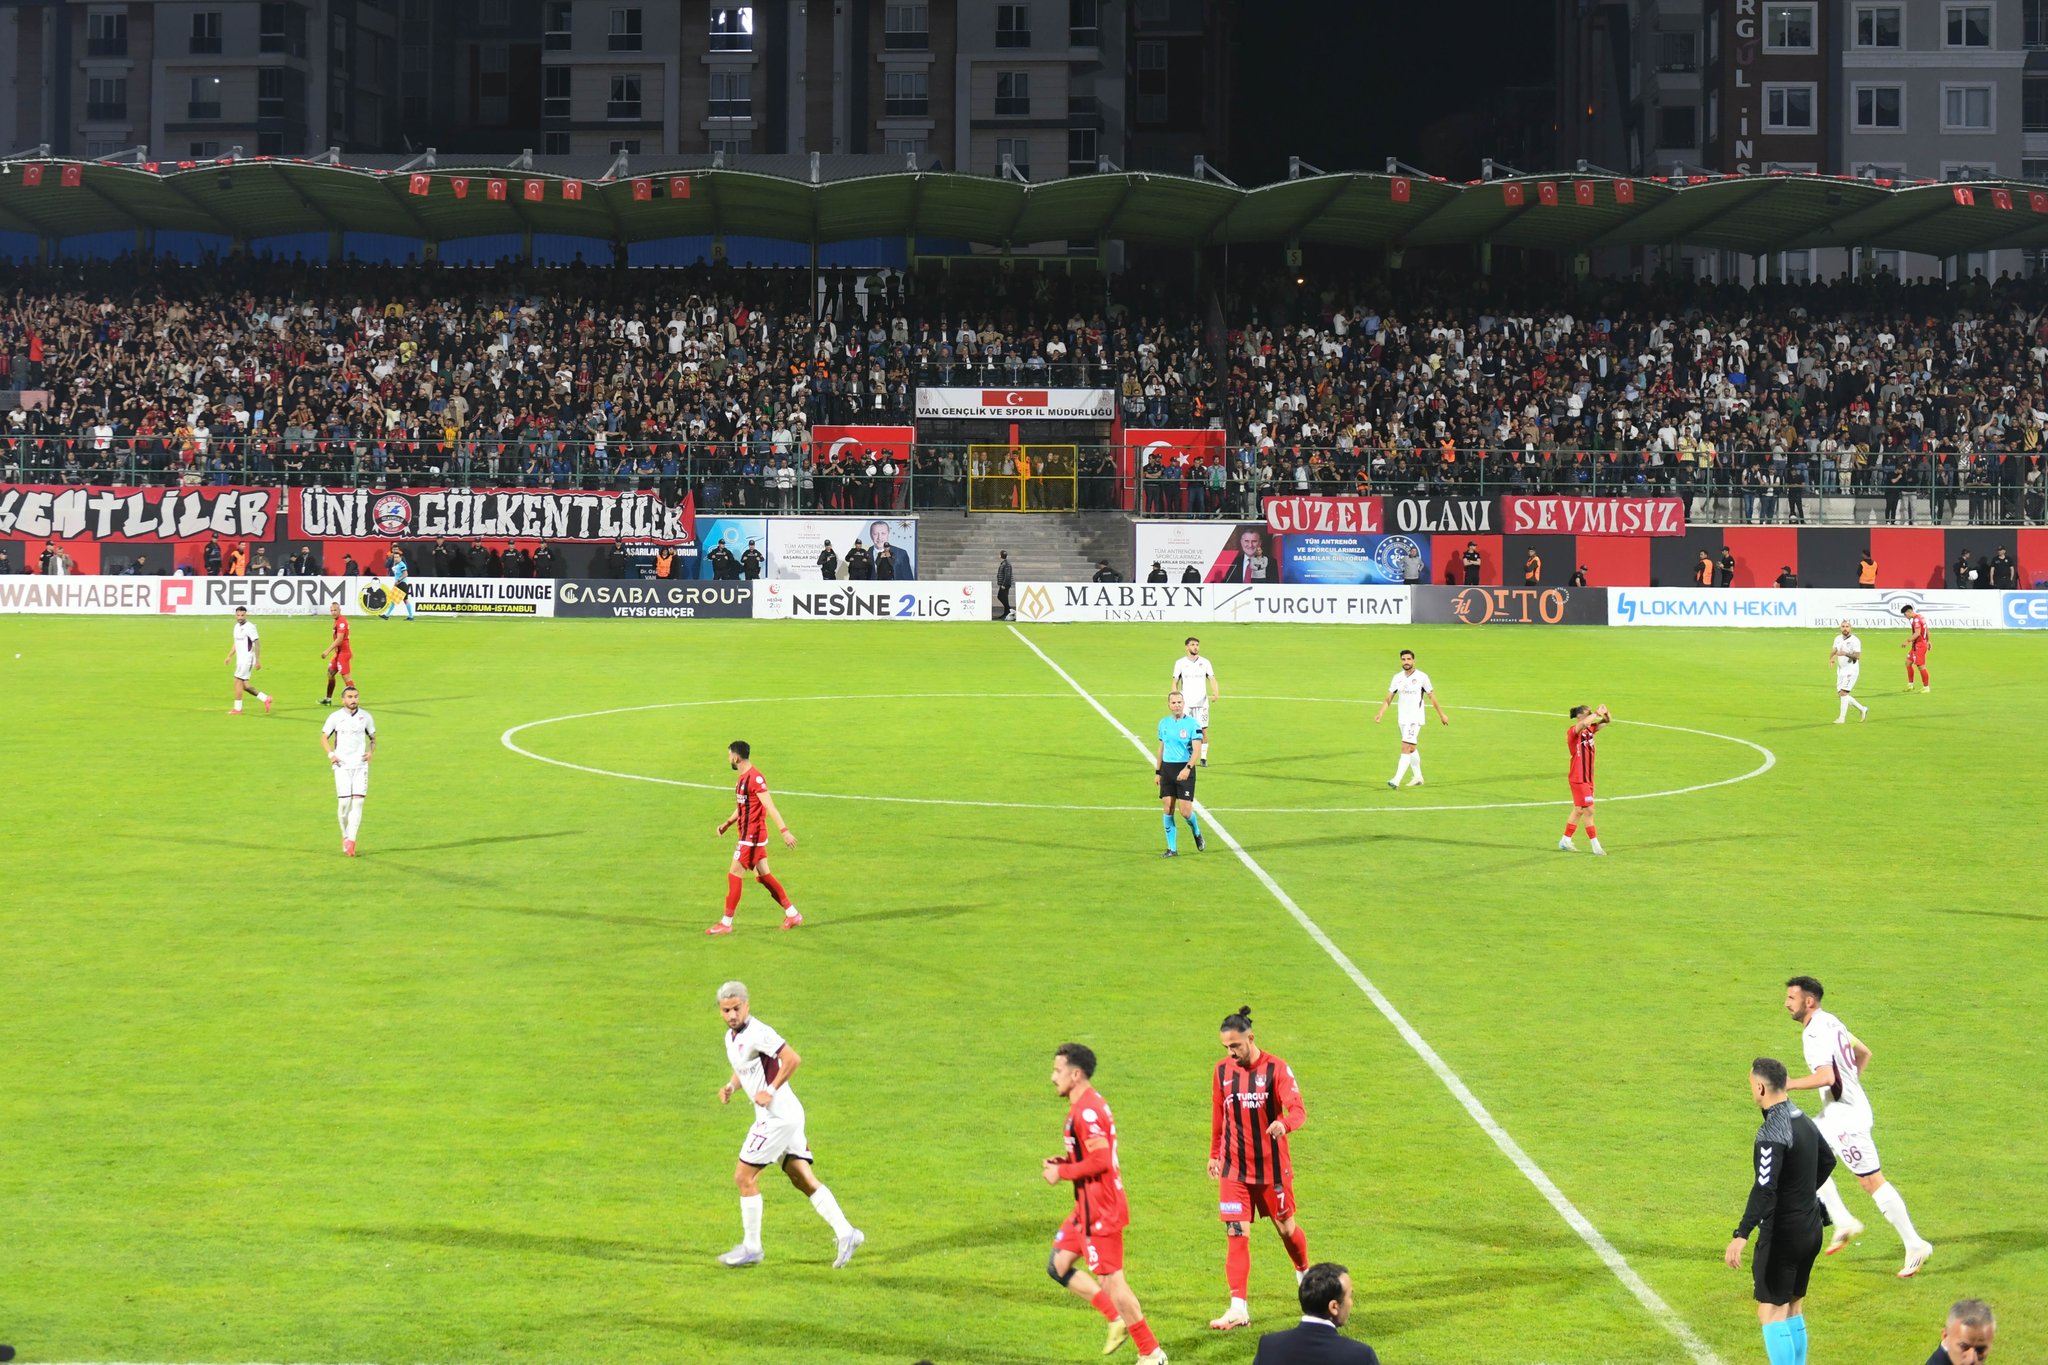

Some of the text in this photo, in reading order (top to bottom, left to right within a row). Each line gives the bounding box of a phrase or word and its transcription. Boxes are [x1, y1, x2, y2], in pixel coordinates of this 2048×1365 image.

[918, 407, 939, 415] VAN
[942, 406, 986, 417] GENÇLİK
[1006, 408, 1032, 416] SPOR
[1036, 407, 1045, 416] İL
[1048, 407, 1113, 417] MÜDÜRLÜĞÜ
[302, 487, 689, 540] ÜNİ GÖLKENTLİLER
[1267, 497, 1678, 534] GÜZEL OLANI SEVMİŞİZ
[206, 579, 346, 606] REFORM
[407, 583, 552, 600] AN KAHVALTI LOUNGE
[559, 582, 751, 604] CASABA GROUP
[1064, 586, 1205, 607] MABEYN
[648, 607, 694, 618] GENÇER
[1254, 597, 1403, 614] TURGUT FIRAT
[1640, 600, 1727, 616] LOKMAN
[1105, 608, 1165, 622] İNŞAAT
[1814, 618, 1839, 627] BETA
[1236, 1092, 1270, 1101] TURGUT
[1841, 1145, 1862, 1164] 66
[1276, 1192, 1285, 1209] 7
